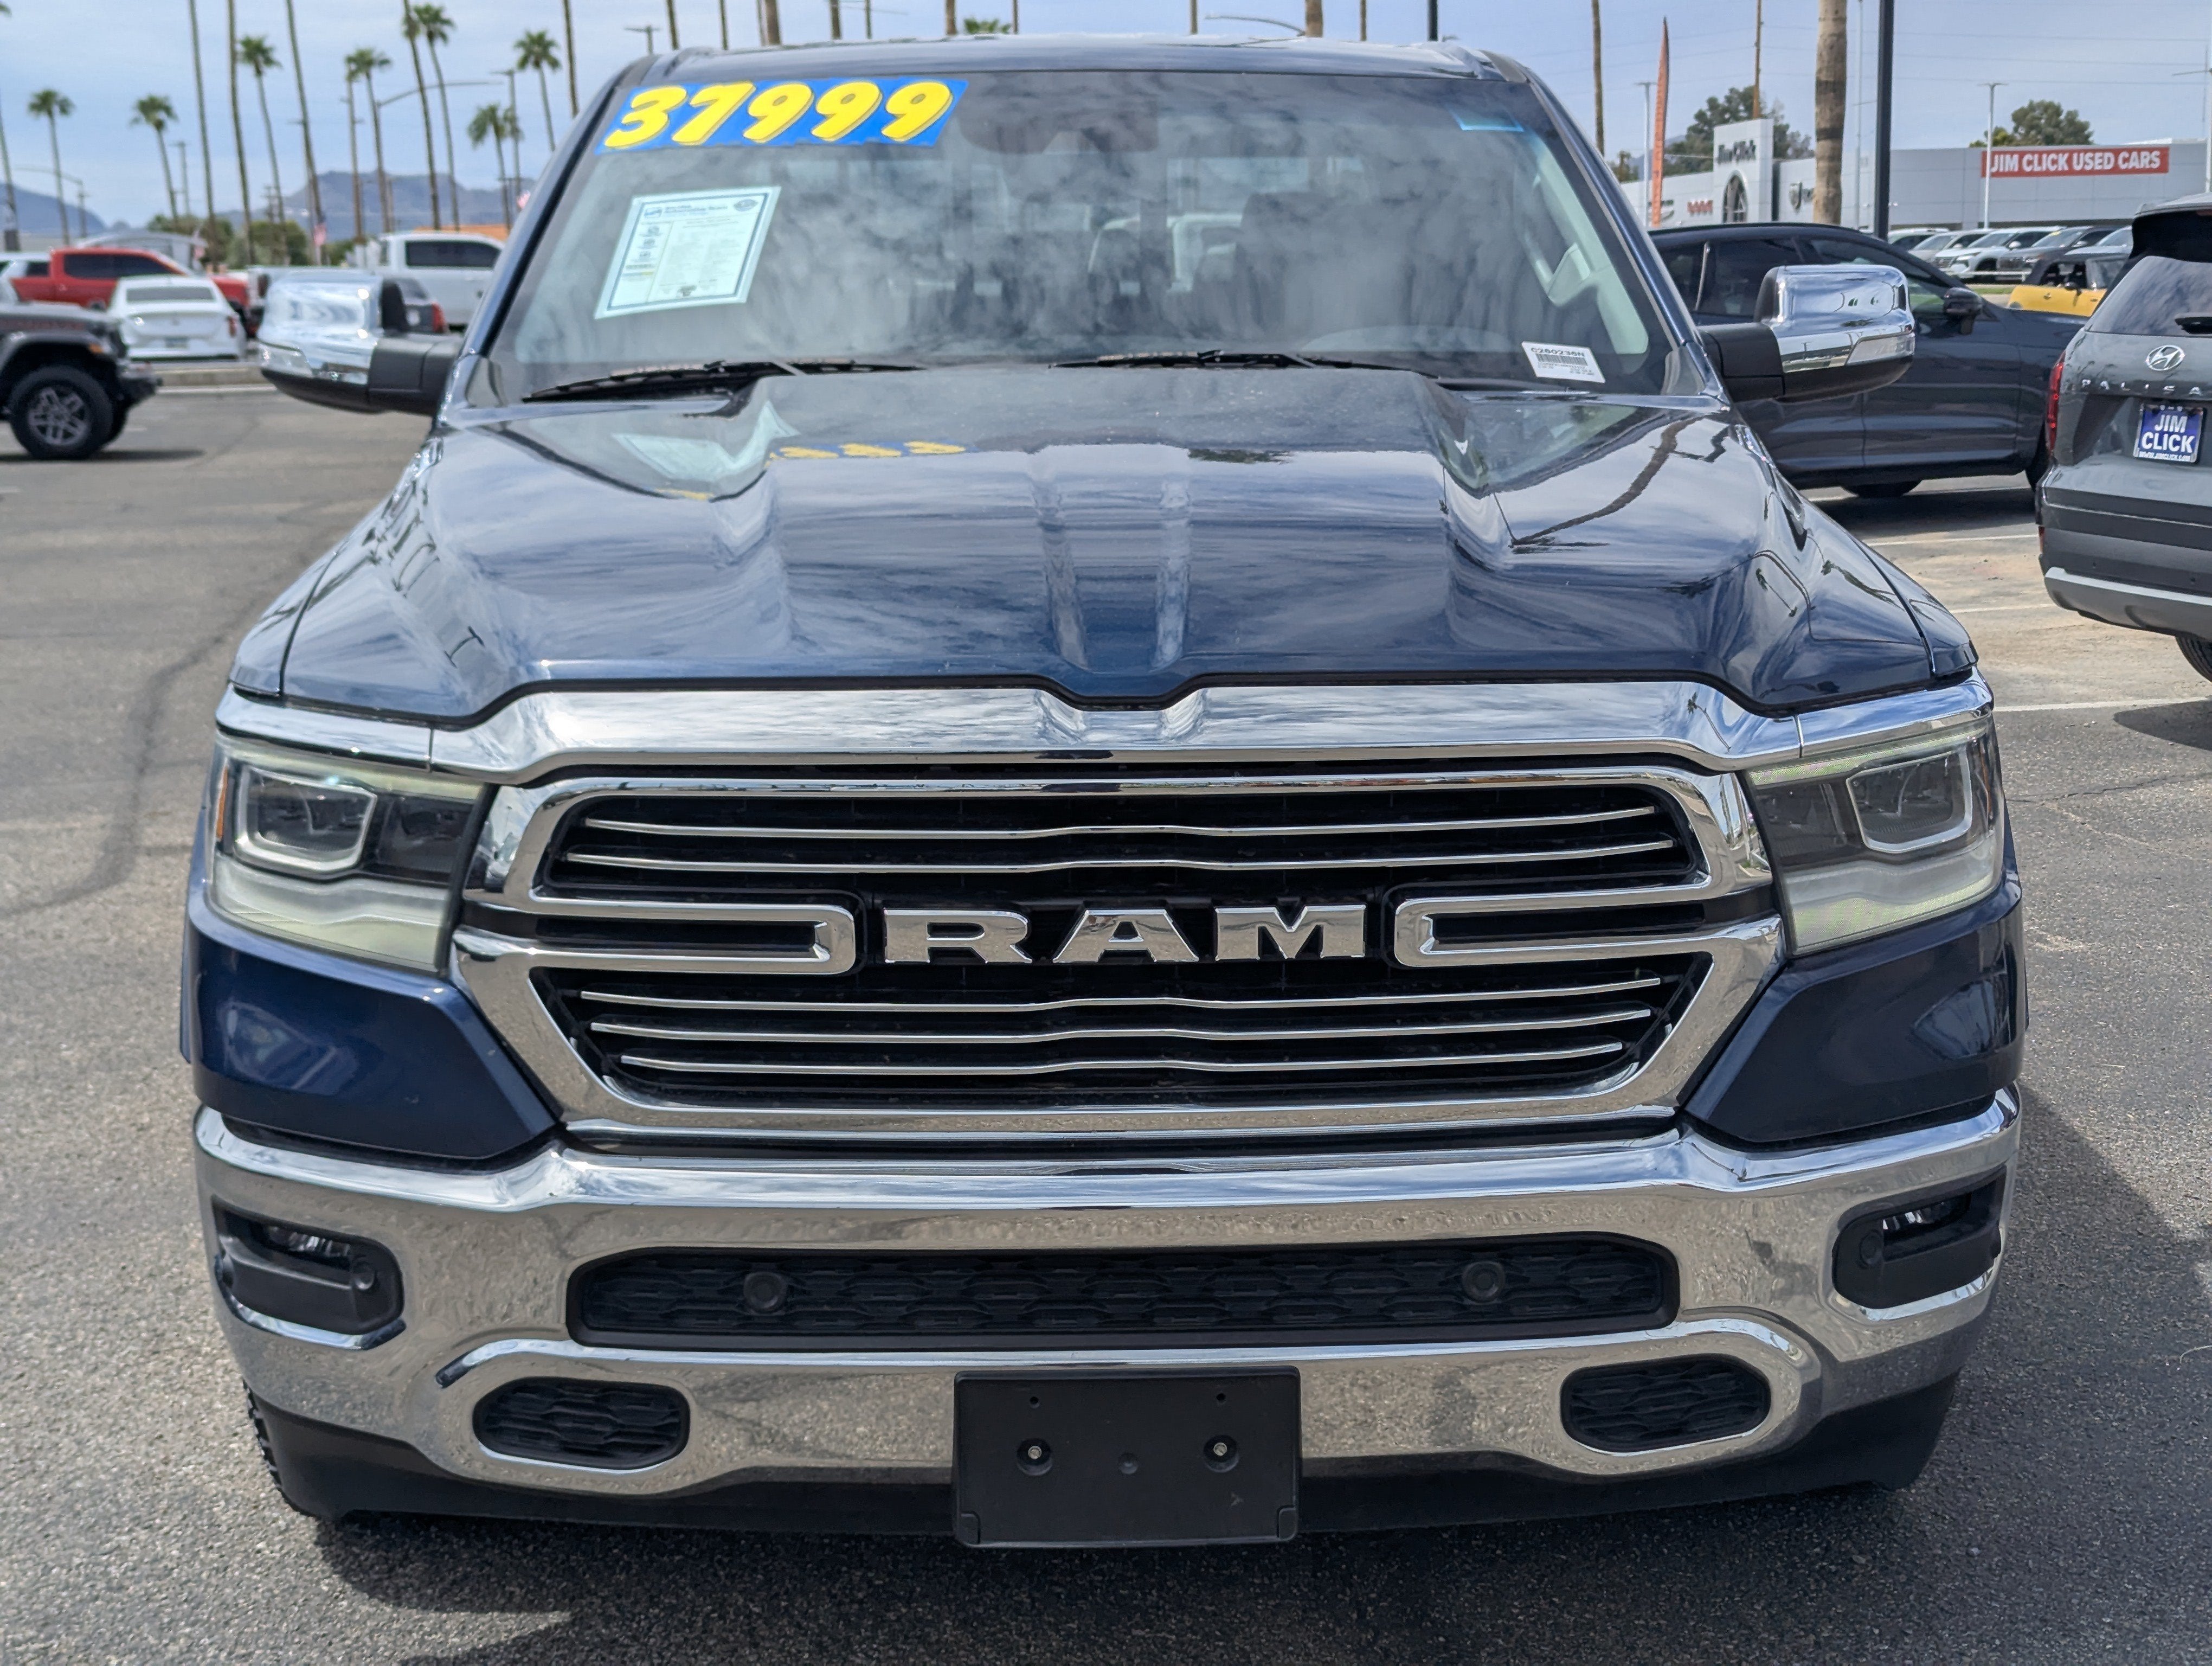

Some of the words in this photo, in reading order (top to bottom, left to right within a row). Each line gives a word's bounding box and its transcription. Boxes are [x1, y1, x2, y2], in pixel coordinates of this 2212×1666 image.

[604, 81, 953, 148] 37999
[1991, 154, 2019, 172] JIM
[2022, 152, 2069, 171] CLICK
[2072, 151, 2114, 170] USED
[2118, 150, 2161, 169] CARS
[2154, 414, 2188, 433] JIM
[2142, 432, 2195, 453] CLICK
[884, 905, 1366, 964] RAM
